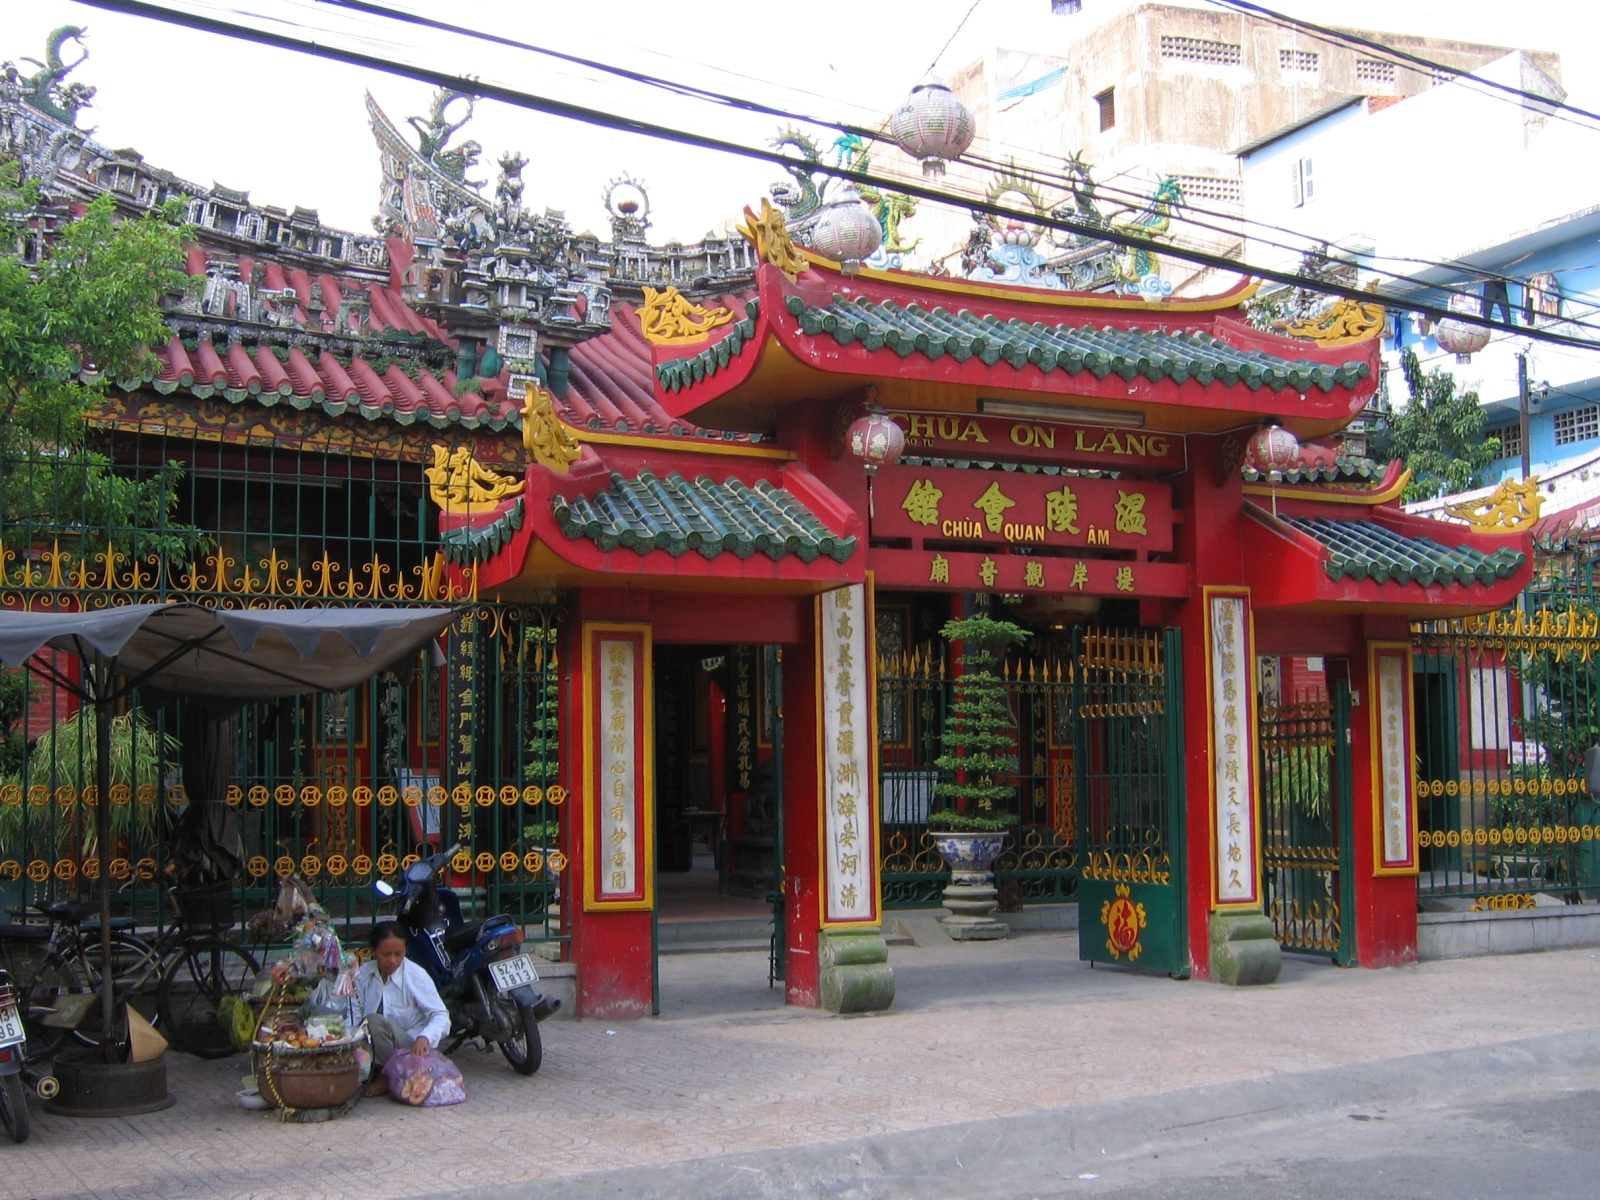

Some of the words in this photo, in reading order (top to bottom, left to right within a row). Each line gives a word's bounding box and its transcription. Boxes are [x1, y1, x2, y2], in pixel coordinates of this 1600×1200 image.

[942, 516, 983, 538] CHÙA
[1004, 523, 1045, 542] QUAN
[1087, 525, 1110, 546] ÂM
[501, 970, 531, 988] 1813
